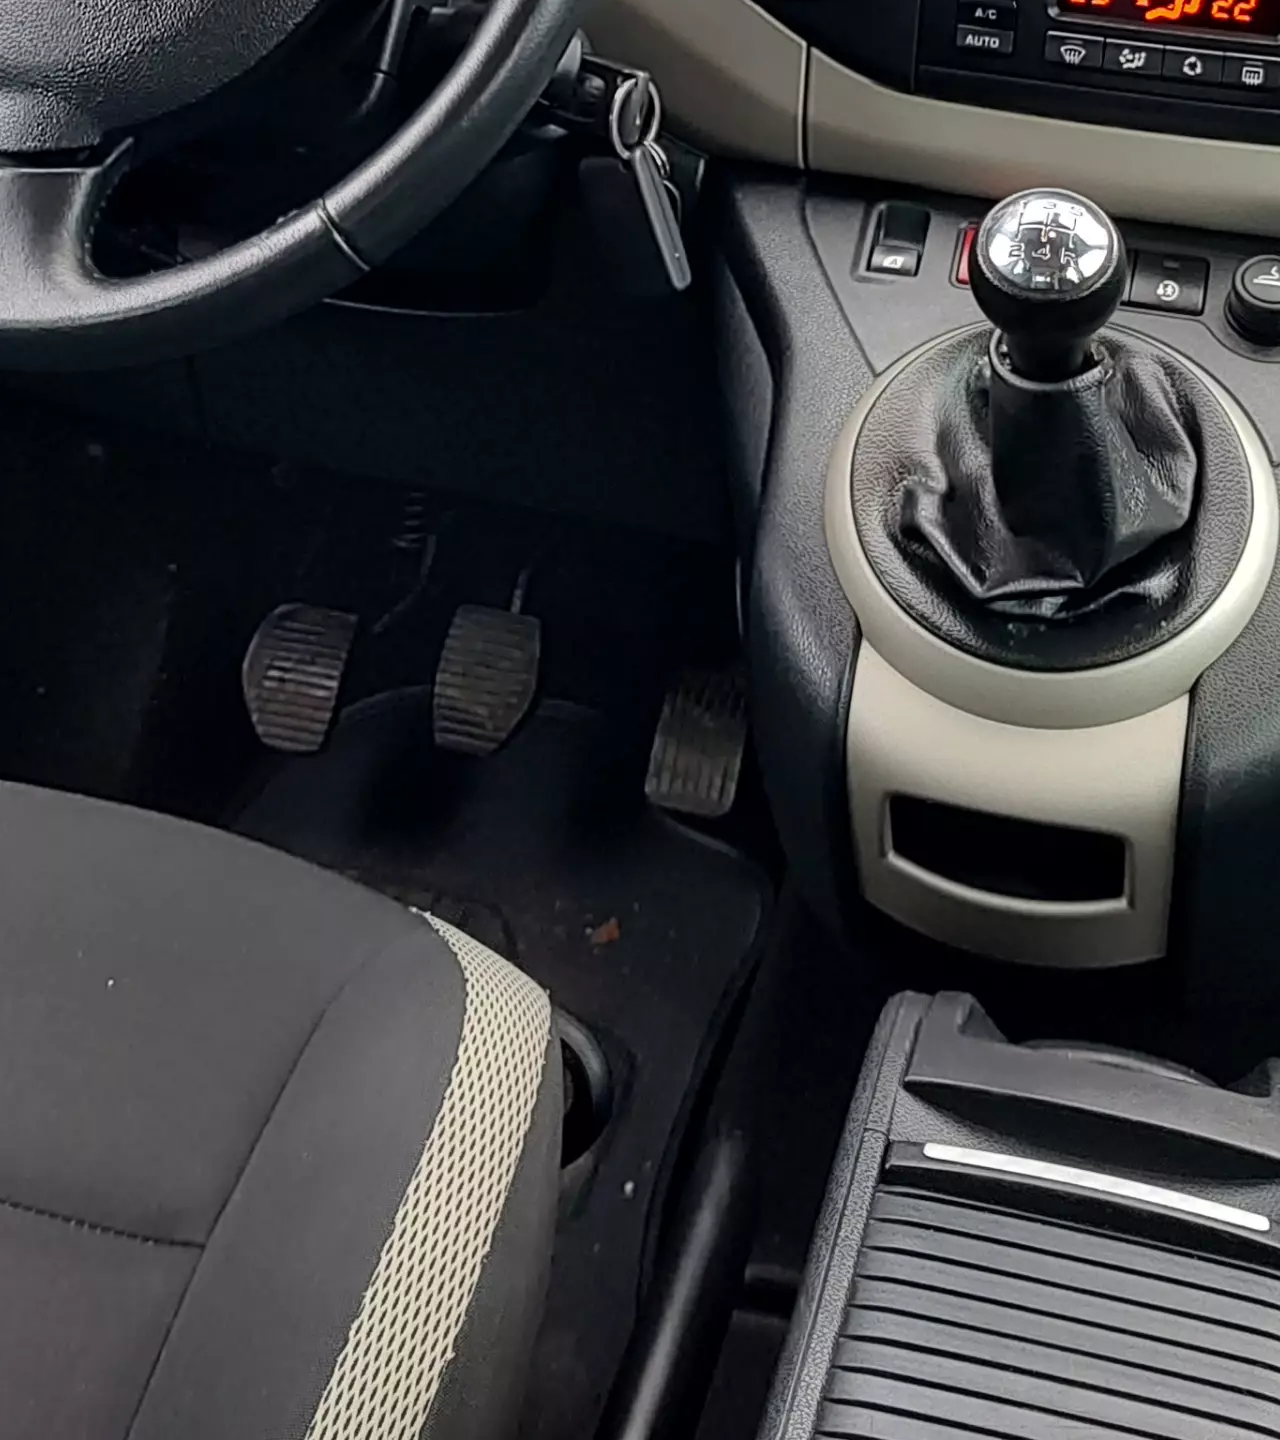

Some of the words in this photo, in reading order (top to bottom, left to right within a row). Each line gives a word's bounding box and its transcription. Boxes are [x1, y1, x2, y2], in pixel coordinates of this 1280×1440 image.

[974, 6, 998, 20] A/C
[964, 32, 1001, 50] AUTO
[1030, 243, 1052, 261] 4
